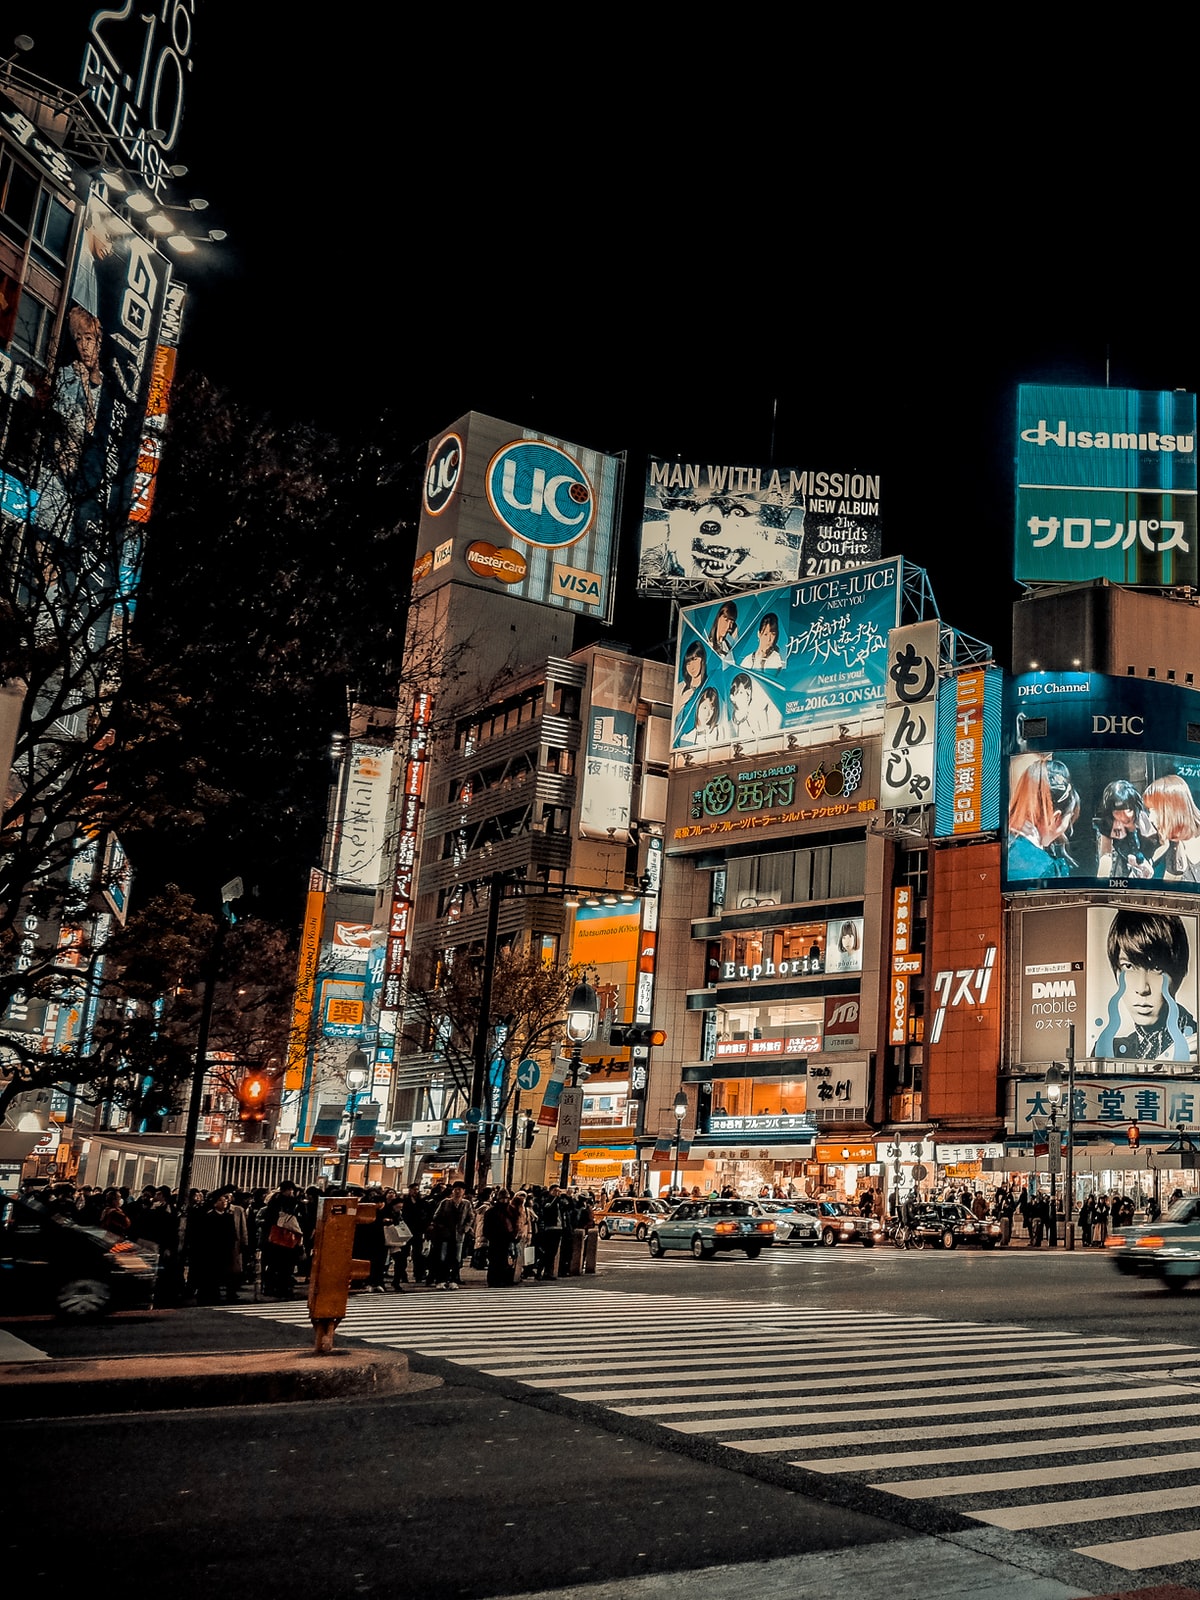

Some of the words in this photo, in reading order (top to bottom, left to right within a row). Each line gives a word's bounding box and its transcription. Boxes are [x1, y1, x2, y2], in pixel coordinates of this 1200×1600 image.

[80, 42, 171, 206] RELEASE
[1020, 419, 1194, 453] Hisamitsu
[502, 458, 585, 525] UC
[650, 461, 699, 489] MAN
[706, 465, 761, 492] WITH
[768, 469, 785, 493] A
[789, 470, 881, 500] MISSION
[808, 498, 836, 513] NEW
[838, 500, 879, 516] ALBUM
[834, 517, 857, 529] The
[1027, 516, 1189, 553] サロンパス
[467, 550, 527, 575] MasterCard
[558, 573, 600, 598] VISA
[845, 690, 862, 703] ON
[863, 690, 886, 702] SAL
[1018, 684, 1043, 696] DHC
[1044, 682, 1090, 695] Channel
[885, 643, 935, 801] もんじゃ
[1092, 714, 1145, 736] DHC
[954, 677, 979, 824] 三千里薬品
[736, 776, 797, 812] 西村
[1108, 879, 1129, 889] DHC
[723, 955, 821, 981] Euphoria
[929, 947, 997, 1044] クスリ
[1032, 980, 1077, 999] DMM
[333, 1001, 360, 1022] 薬
[827, 1001, 860, 1028] JTB
[1032, 998, 1077, 1015] mobile
[1025, 1088, 1196, 1123] 大盛堂書店
[560, 1094, 575, 1147] 道玄坂
